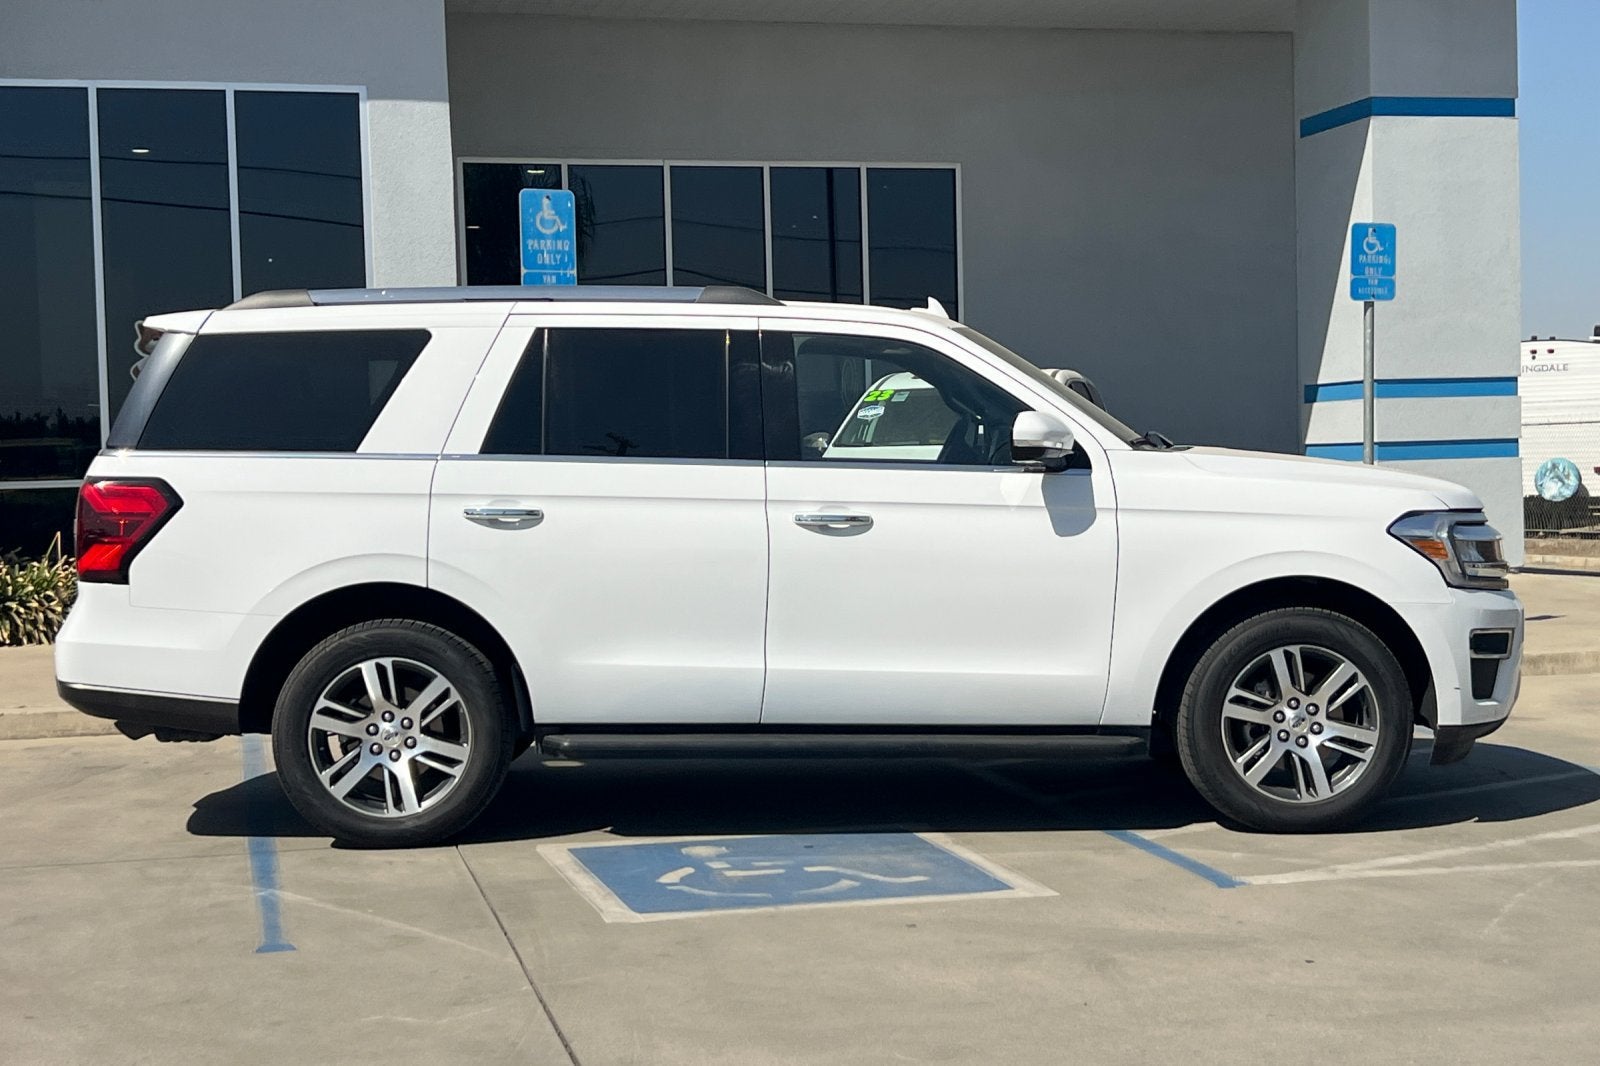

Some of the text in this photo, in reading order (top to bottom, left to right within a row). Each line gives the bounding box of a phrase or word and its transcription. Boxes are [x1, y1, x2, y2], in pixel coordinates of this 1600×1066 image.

[527, 239, 570, 251] PARKING
[537, 253, 561, 265] ONLY
[1521, 363, 1569, 373] INGDALE
[863, 389, 895, 402] 23
